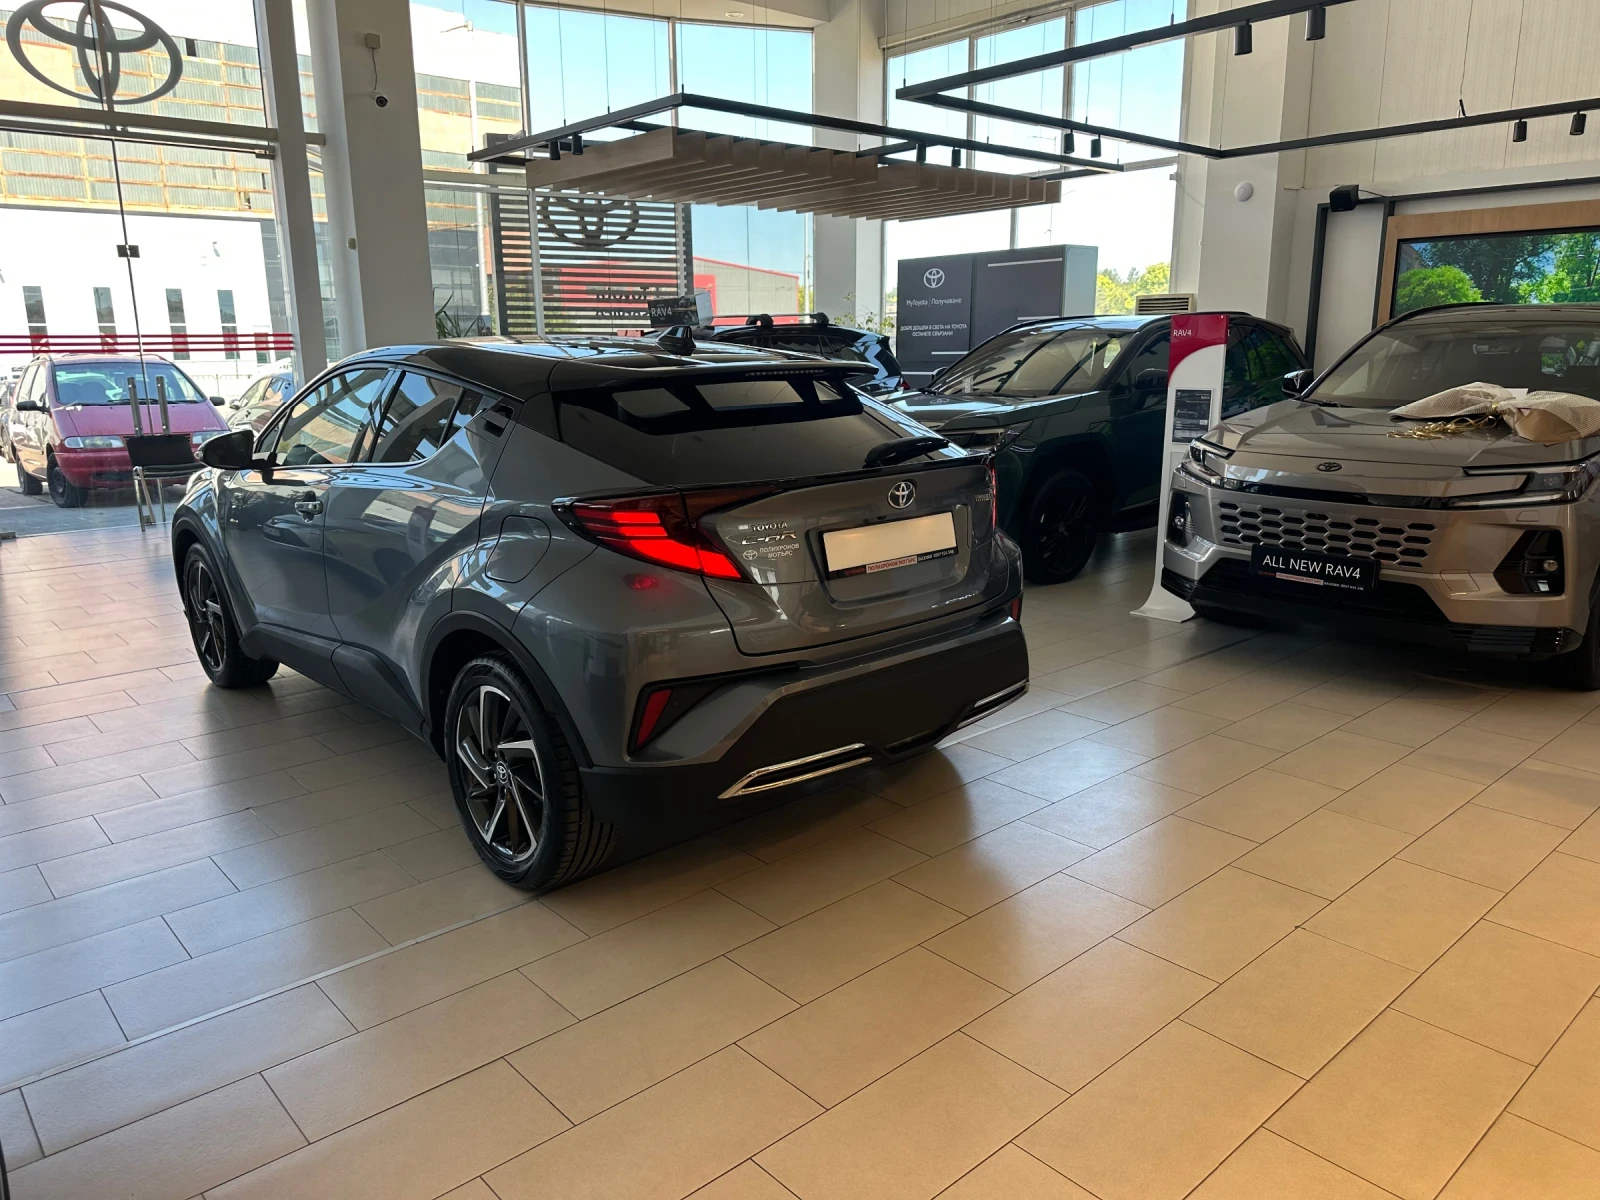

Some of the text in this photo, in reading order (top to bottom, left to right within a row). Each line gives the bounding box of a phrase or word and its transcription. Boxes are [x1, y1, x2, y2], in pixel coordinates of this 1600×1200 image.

[651, 306, 672, 317] RAV4
[1173, 329, 1192, 337] RAV4
[752, 522, 788, 531] TOYOTA
[741, 531, 797, 544] C-HR
[759, 543, 800, 553] ПОЛИХРОНОВ
[768, 550, 793, 558] МОТЪРС
[867, 561, 898, 572] ПОЛИХРОНОВ
[898, 557, 916, 565] МОТЪРС
[1262, 555, 1360, 579] ALL NEW RAV4
